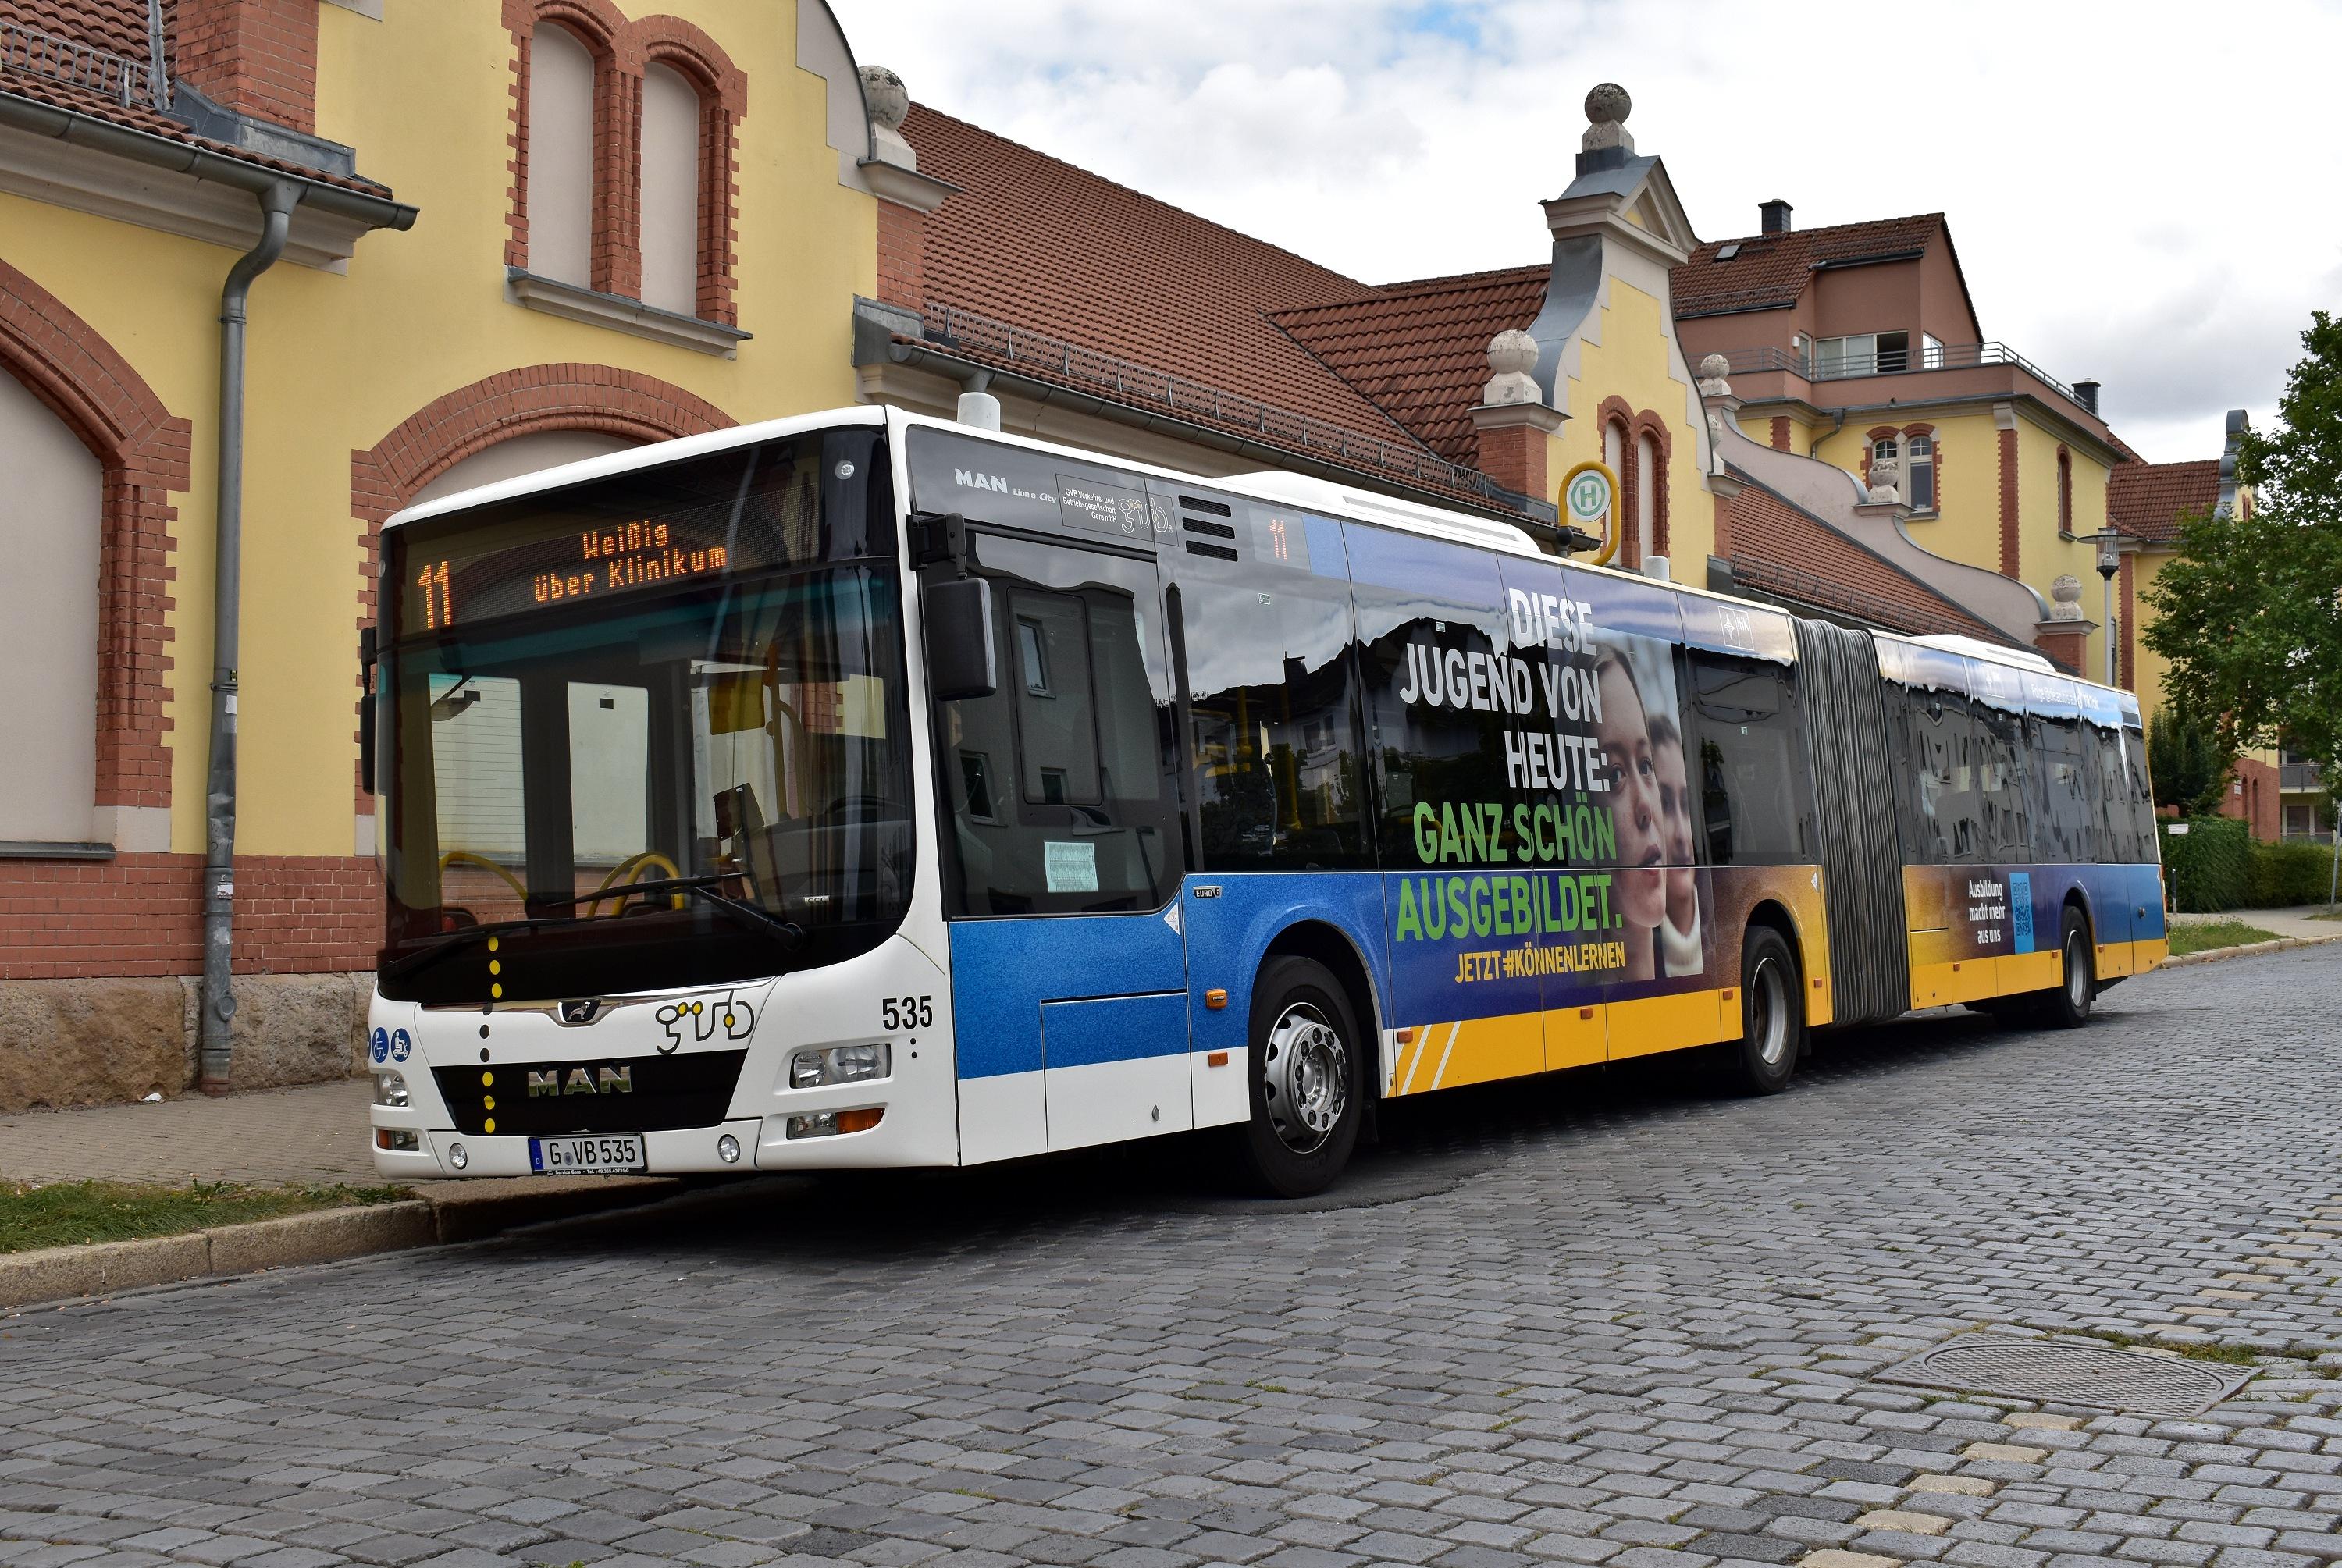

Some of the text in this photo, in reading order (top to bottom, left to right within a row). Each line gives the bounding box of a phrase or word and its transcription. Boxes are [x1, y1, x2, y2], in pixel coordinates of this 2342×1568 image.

[955, 468, 1008, 494] MAN
[1013, 488, 1057, 504] Lion's City
[1065, 488, 1115, 505] GVB Verkehrs- und
[1579, 484, 1597, 508] H
[1062, 496, 1116, 514] Betriebsgesellschaft
[1091, 511, 1117, 523] Gera mbH
[582, 520, 669, 560] Weißig
[1269, 518, 1287, 560] 11
[535, 546, 727, 603] über Klinikum
[417, 560, 450, 628] 11
[1508, 588, 1597, 656] DIESE
[1399, 642, 1603, 724] JUGEND VON
[1504, 730, 1611, 792] HEUTE:
[1413, 791, 1618, 864] GANZ SCHÖN
[1969, 880, 2003, 901] Ausbildung
[1396, 876, 1623, 941] AUSGEBILDET.
[1969, 901, 2006, 921] macht mehr
[1977, 929, 2001, 944] aus uns
[1454, 951, 1501, 983] JETZT
[882, 995, 934, 1031] 535
[527, 1064, 632, 1098] MAN
